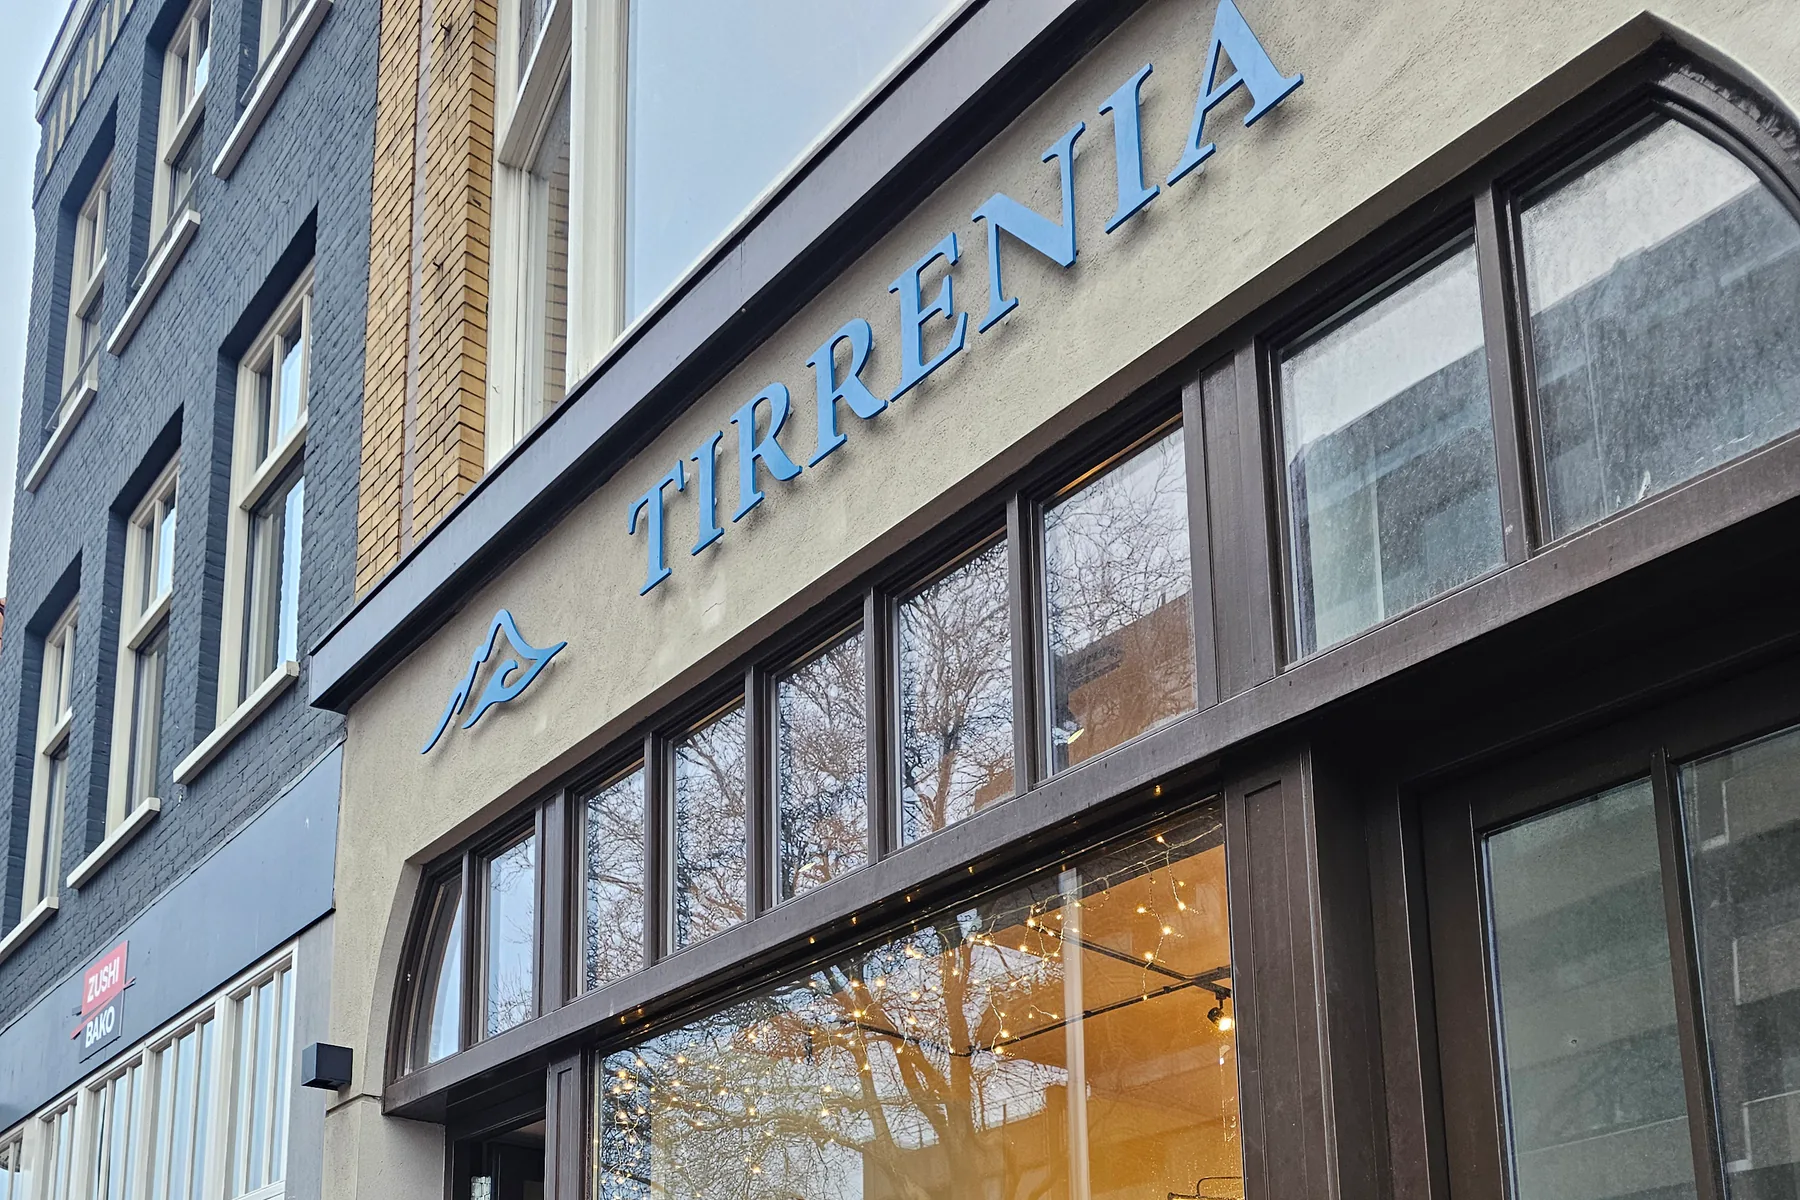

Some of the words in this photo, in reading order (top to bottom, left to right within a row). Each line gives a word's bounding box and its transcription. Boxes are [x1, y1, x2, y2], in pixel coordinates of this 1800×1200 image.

[628, 0, 1304, 596] TIRRENIA
[87, 957, 120, 1004] ZUSHI
[85, 1005, 115, 1049] BAKO
